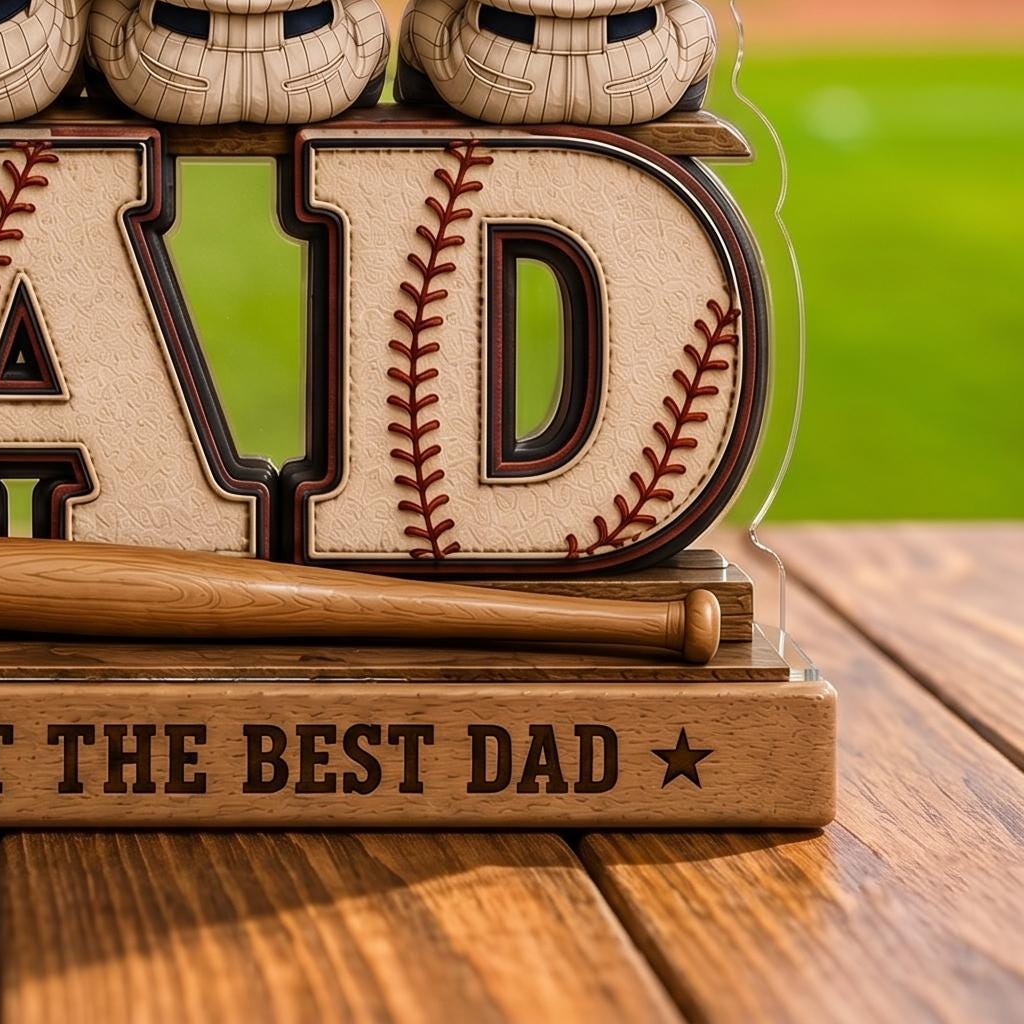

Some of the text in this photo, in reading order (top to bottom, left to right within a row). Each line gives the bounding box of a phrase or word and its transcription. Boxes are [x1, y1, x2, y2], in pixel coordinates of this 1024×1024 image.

[47, 723, 207, 794] THE
[243, 723, 435, 795] BEST
[467, 723, 619, 794] DAD
